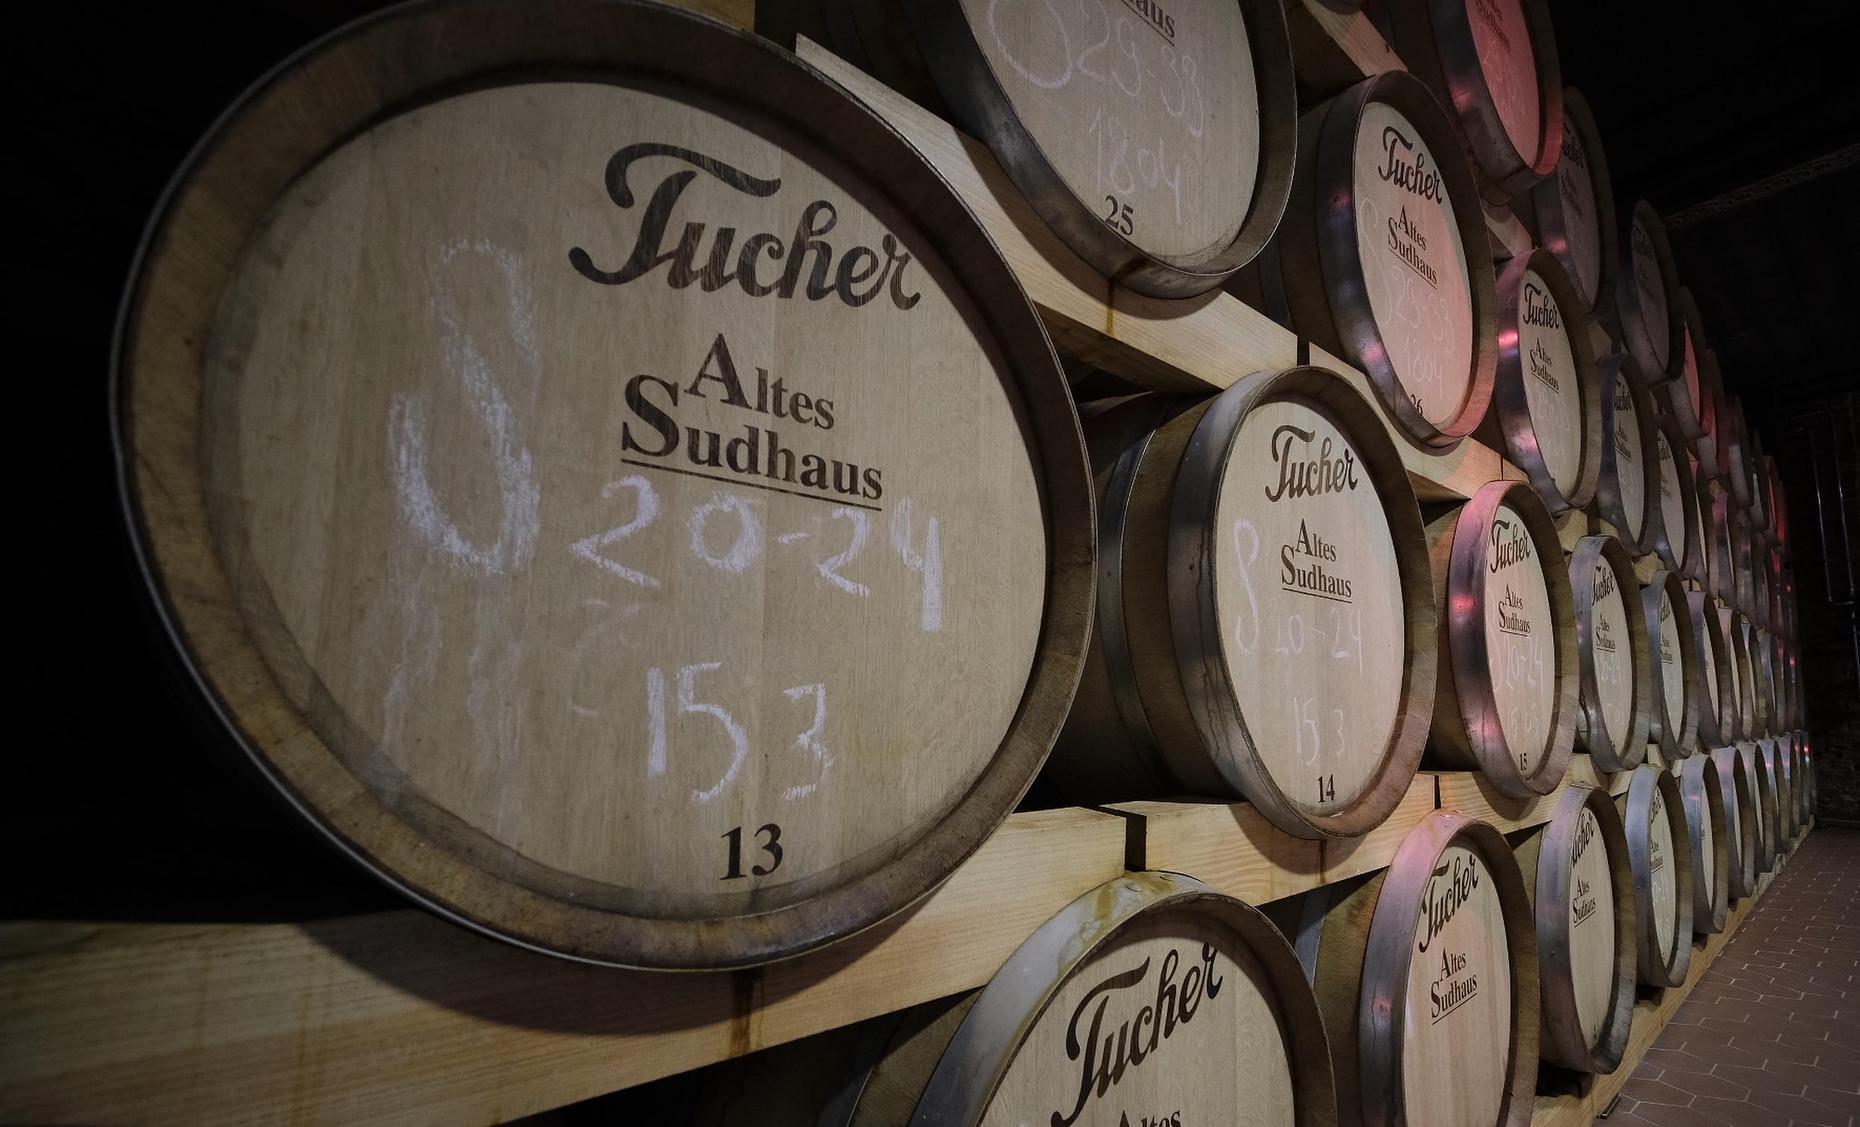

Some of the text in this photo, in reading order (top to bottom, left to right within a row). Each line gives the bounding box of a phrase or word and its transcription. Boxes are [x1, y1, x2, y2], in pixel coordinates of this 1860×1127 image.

[1378, 126, 1443, 204] Tucher
[569, 142, 921, 310] Tucher
[1104, 195, 1134, 236] 25
[1397, 205, 1427, 251] Altes
[1388, 217, 1438, 286] Sudhaus
[684, 333, 835, 430] Altes
[621, 374, 883, 500] Sudhaus
[1265, 424, 1358, 502] Tucher
[570, 474, 945, 633] 20-24
[1280, 544, 1352, 598] Sudhaus
[1295, 518, 1337, 562] Altes
[1490, 519, 1531, 574] Tucher
[646, 662, 834, 801] 15 3
[1317, 774, 1335, 803] 14
[720, 823, 784, 880] 13
[1419, 854, 1478, 953] Tucher
[1431, 974, 1478, 1018] Sudhaus
[1439, 947, 1467, 982] Altes
[1051, 942, 1223, 1127] Tucher
